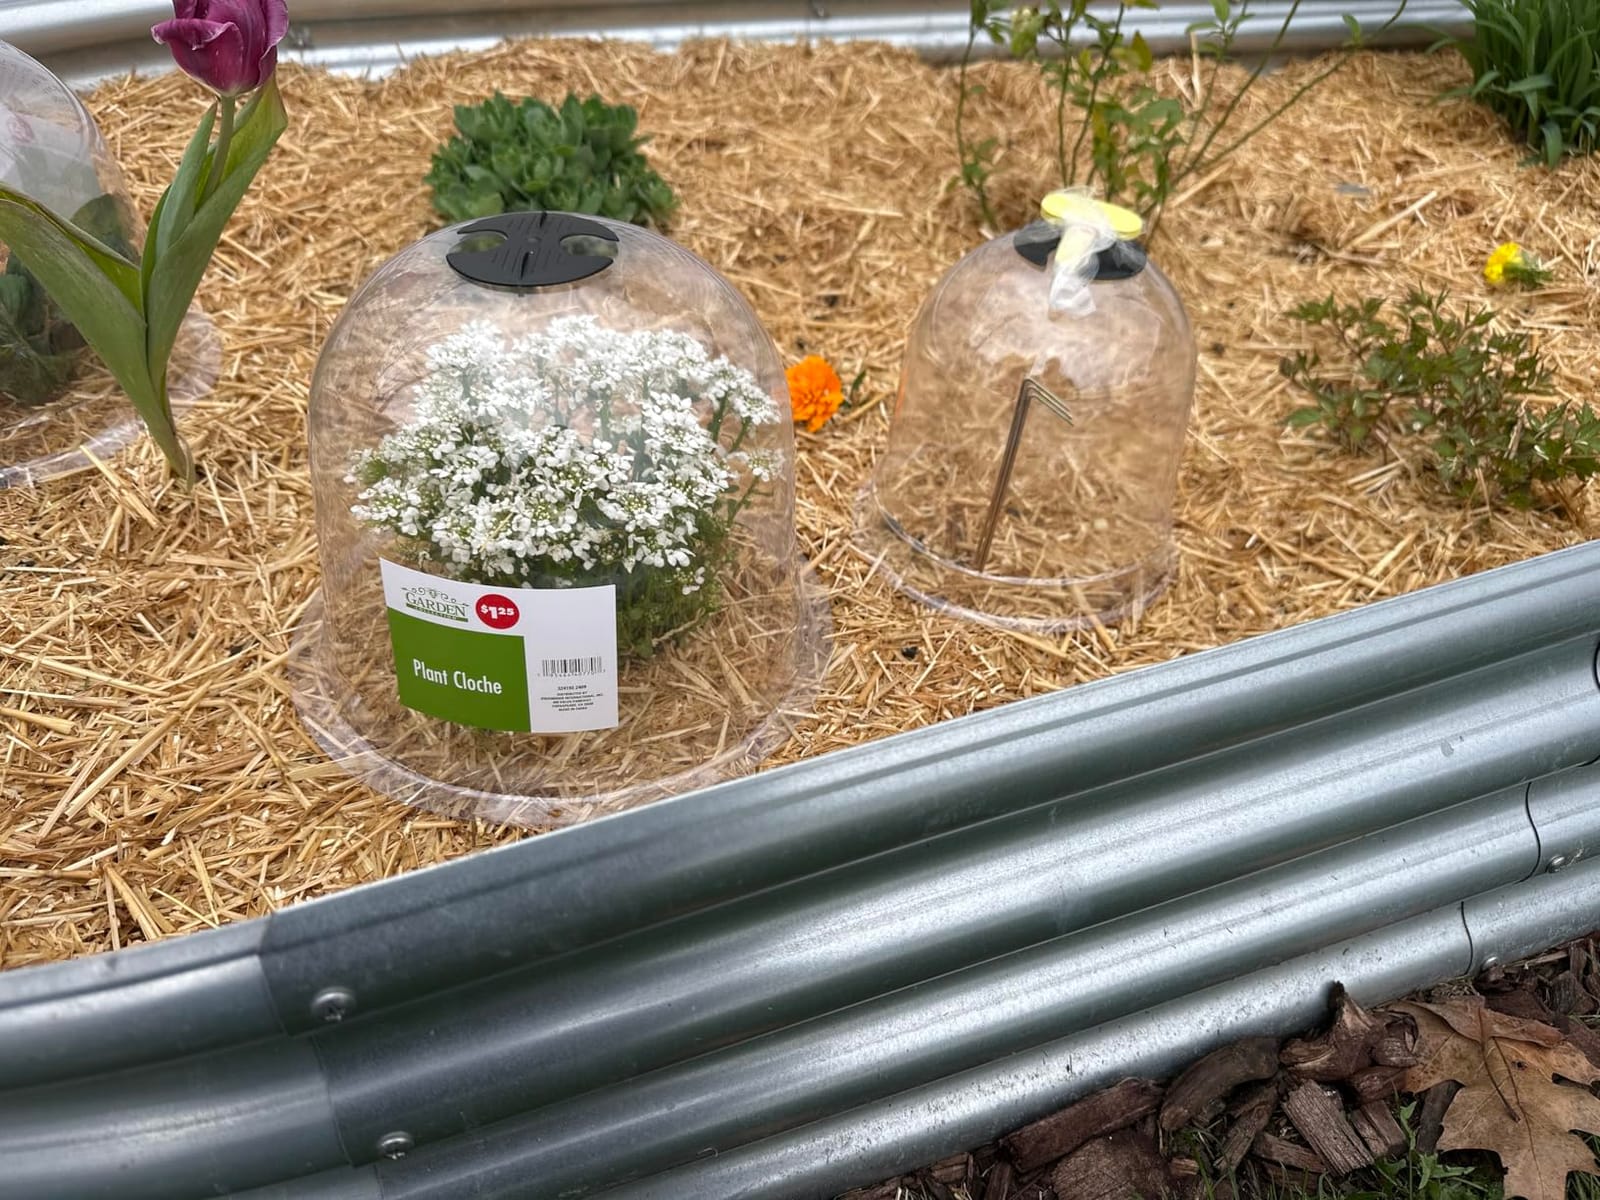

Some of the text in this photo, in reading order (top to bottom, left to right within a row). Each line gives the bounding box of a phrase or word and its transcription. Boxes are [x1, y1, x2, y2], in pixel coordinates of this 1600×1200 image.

[406, 592, 467, 617] GARDEN
[413, 658, 503, 695] Plant Cloche
